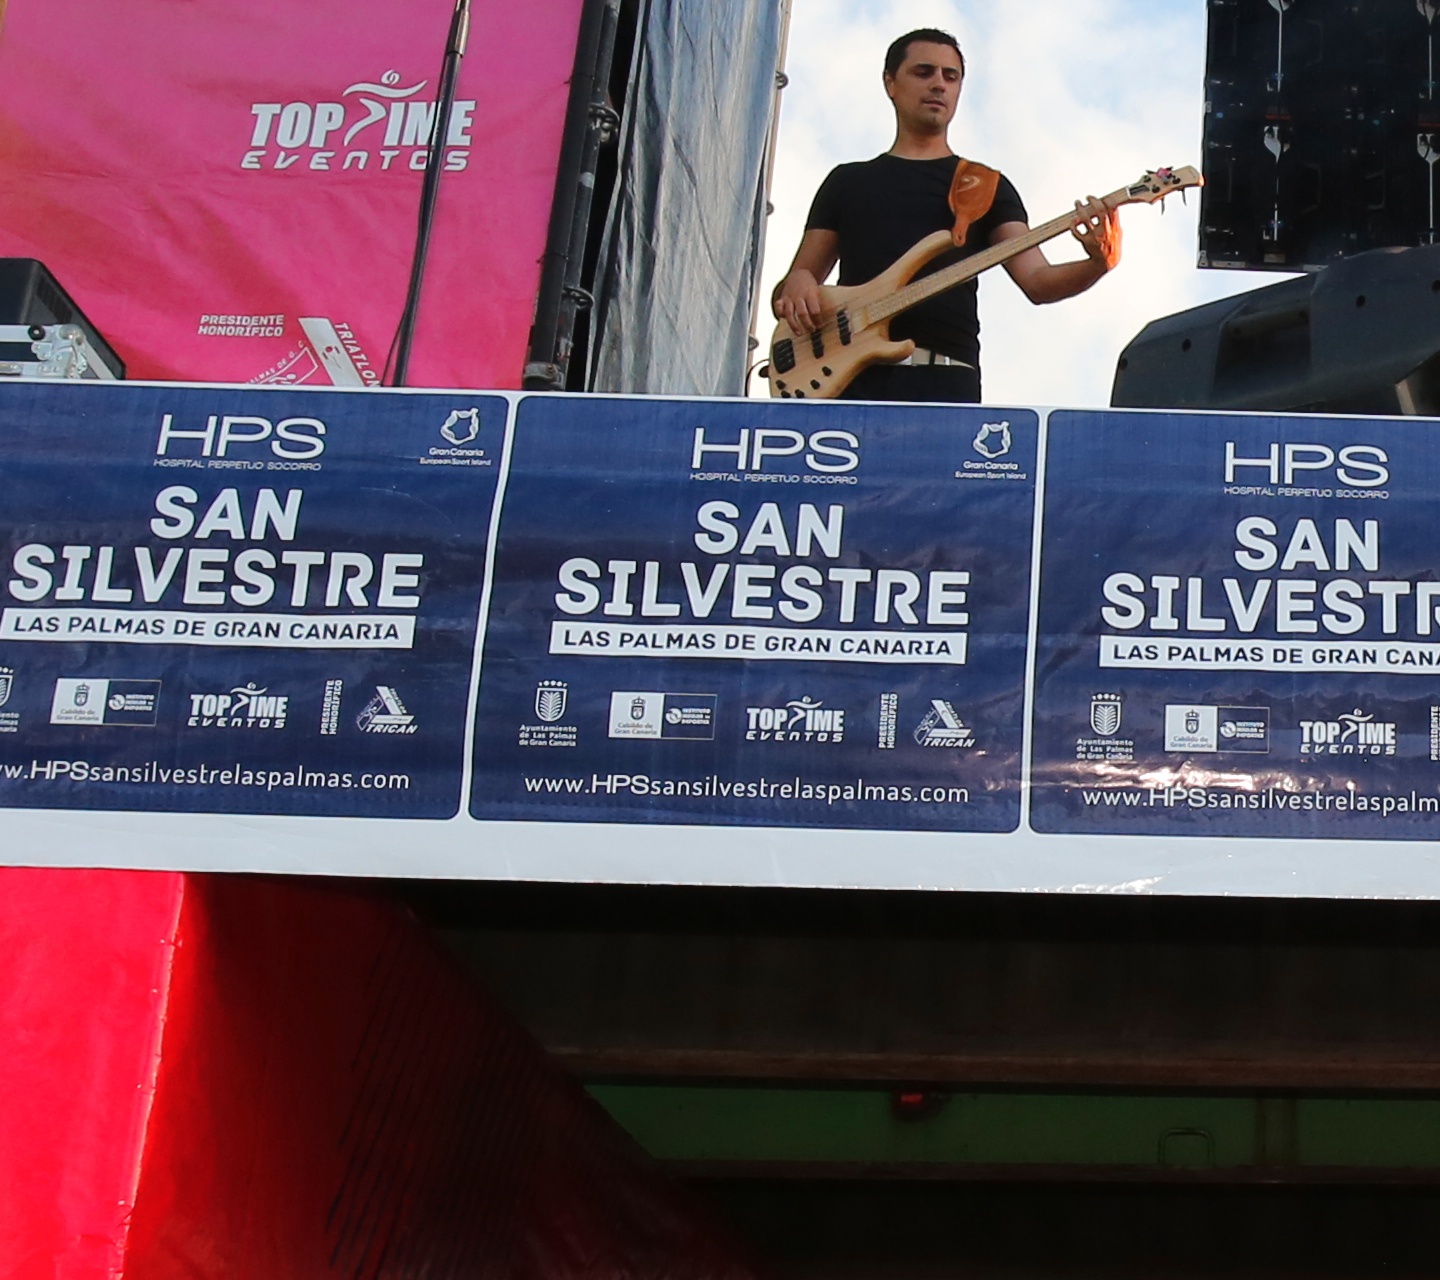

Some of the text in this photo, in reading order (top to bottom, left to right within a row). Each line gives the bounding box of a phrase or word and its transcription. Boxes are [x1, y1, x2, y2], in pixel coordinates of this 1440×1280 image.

[240, 150, 468, 172] EVENTOS
[200, 315, 284, 325] PRESIDENTE
[156, 414, 327, 458] HPS
[690, 427, 859, 472] HPS
[151, 485, 302, 541] SAN
[694, 500, 844, 558] SAN
[8, 544, 423, 609] SILVESTRE
[554, 558, 970, 626] SILVESTRE
[564, 630, 952, 656] LAS PALMAS DE GRAN CANARIA
